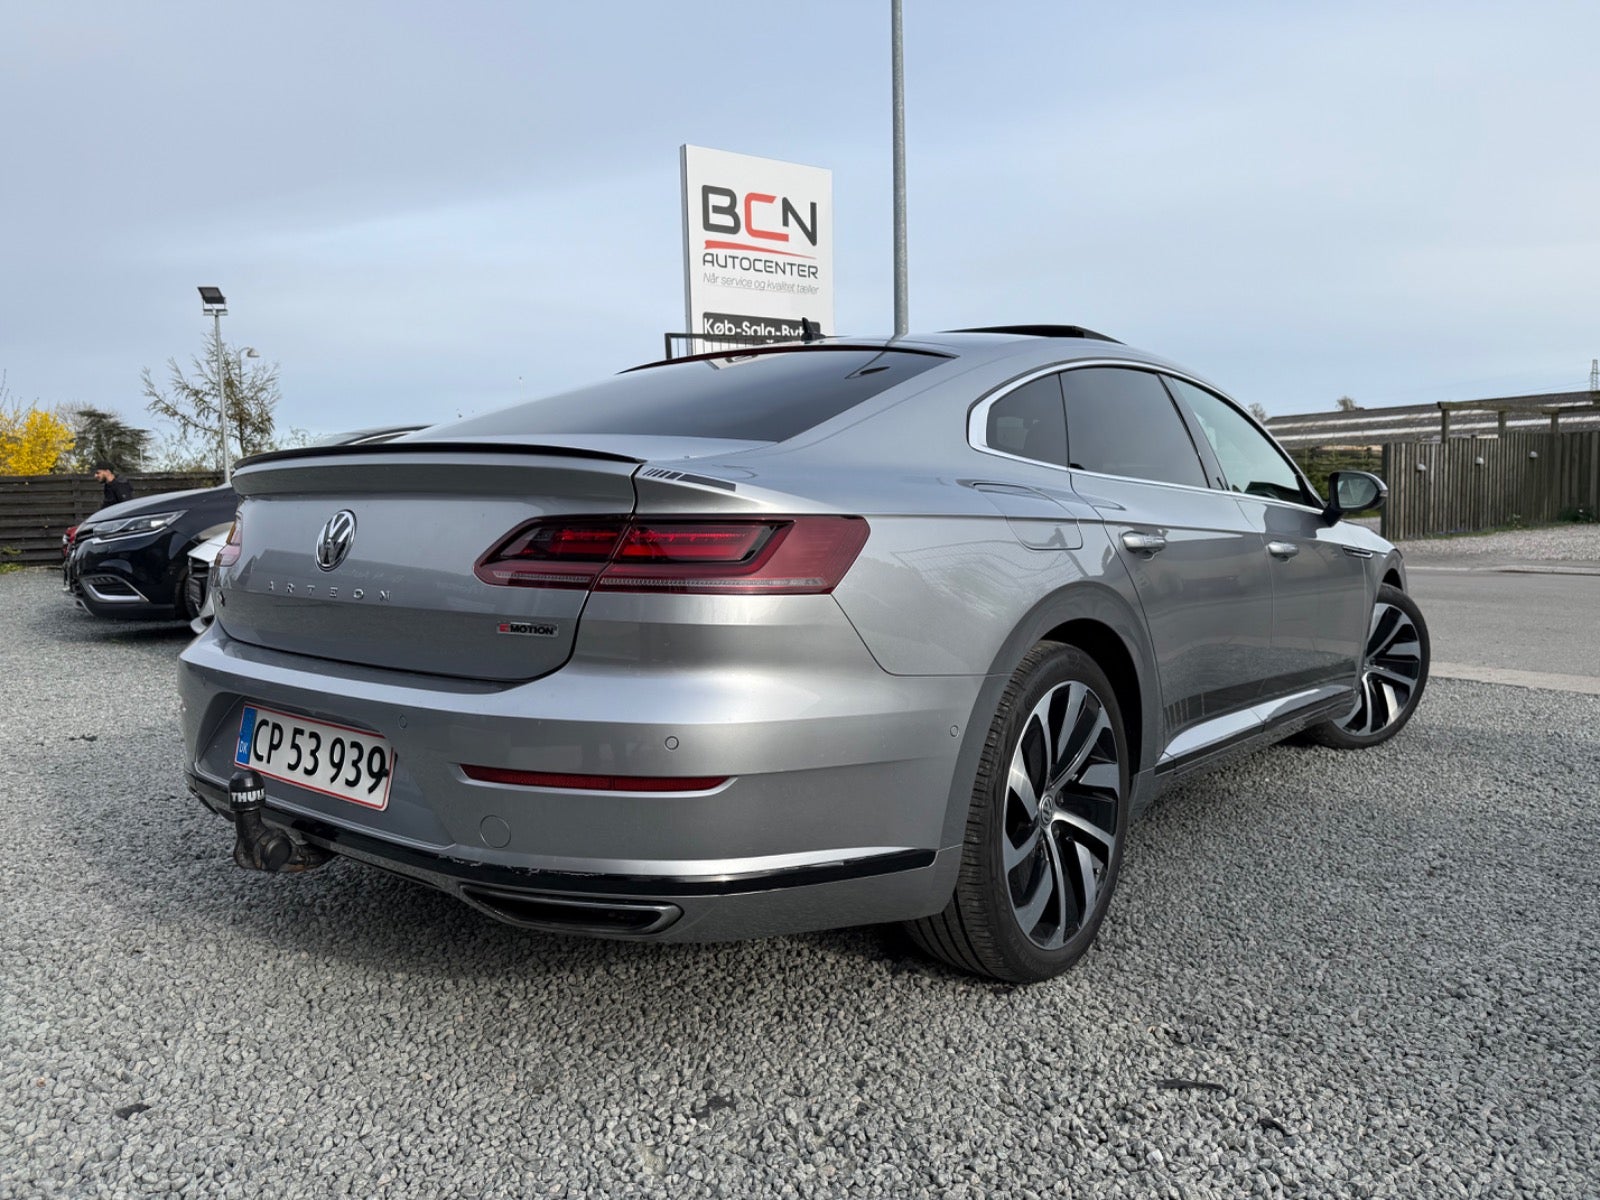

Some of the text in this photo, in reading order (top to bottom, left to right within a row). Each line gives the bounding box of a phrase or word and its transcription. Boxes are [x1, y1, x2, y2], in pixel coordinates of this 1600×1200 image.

[702, 185, 817, 246] BCN
[703, 252, 819, 279] AUTOCENTER
[703, 272, 719, 284] Når
[720, 275, 752, 288] service
[753, 279, 766, 290] og
[268, 580, 391, 601] ARTEON
[253, 718, 388, 794] CP 53 939
